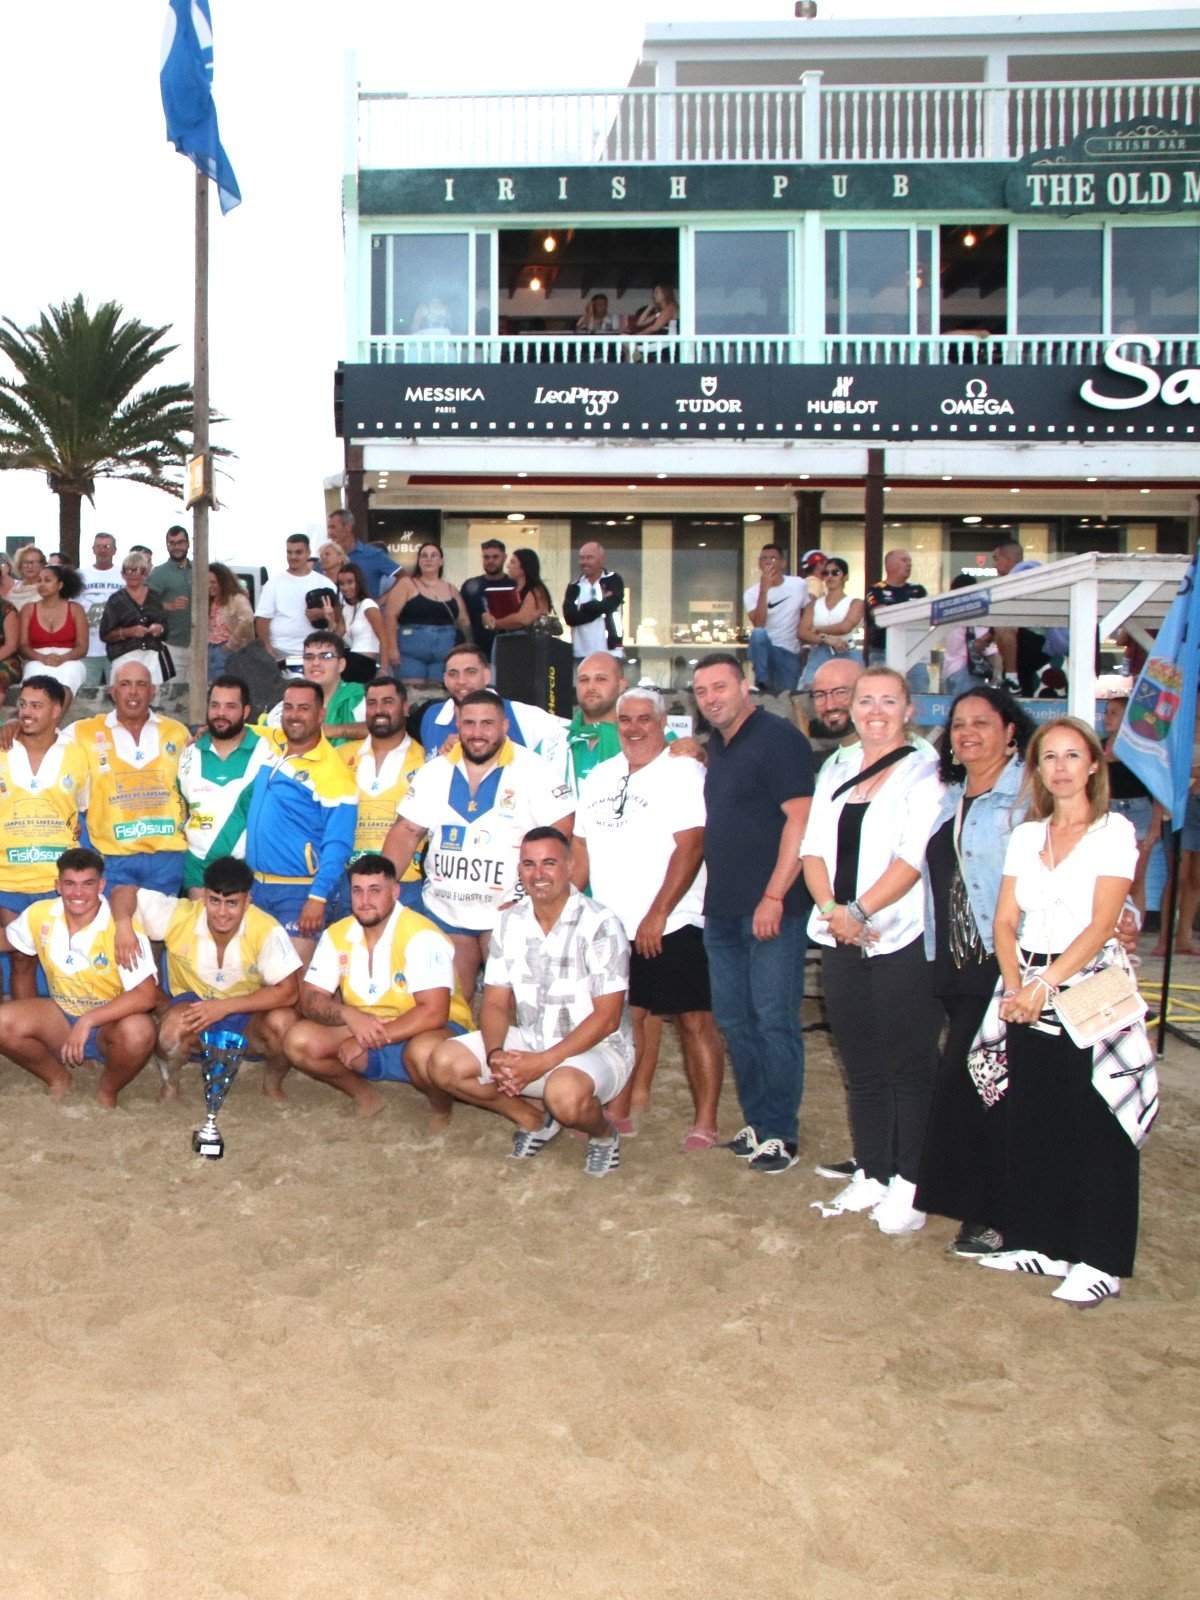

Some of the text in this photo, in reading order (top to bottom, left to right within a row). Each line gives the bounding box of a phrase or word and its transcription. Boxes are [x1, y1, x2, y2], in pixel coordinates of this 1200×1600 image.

[1108, 138, 1187, 151] IRISH BAR
[444, 174, 910, 201] IRISH PUB
[1026, 173, 1096, 206] THE
[1106, 171, 1172, 206] OLD
[404, 386, 486, 402] MESSIKA
[434, 405, 457, 414] PARIS
[676, 399, 743, 414] TUDOR
[807, 399, 878, 414] HUBLOT
[940, 398, 1015, 415] OMEGA
[434, 853, 505, 885] EWASTE
